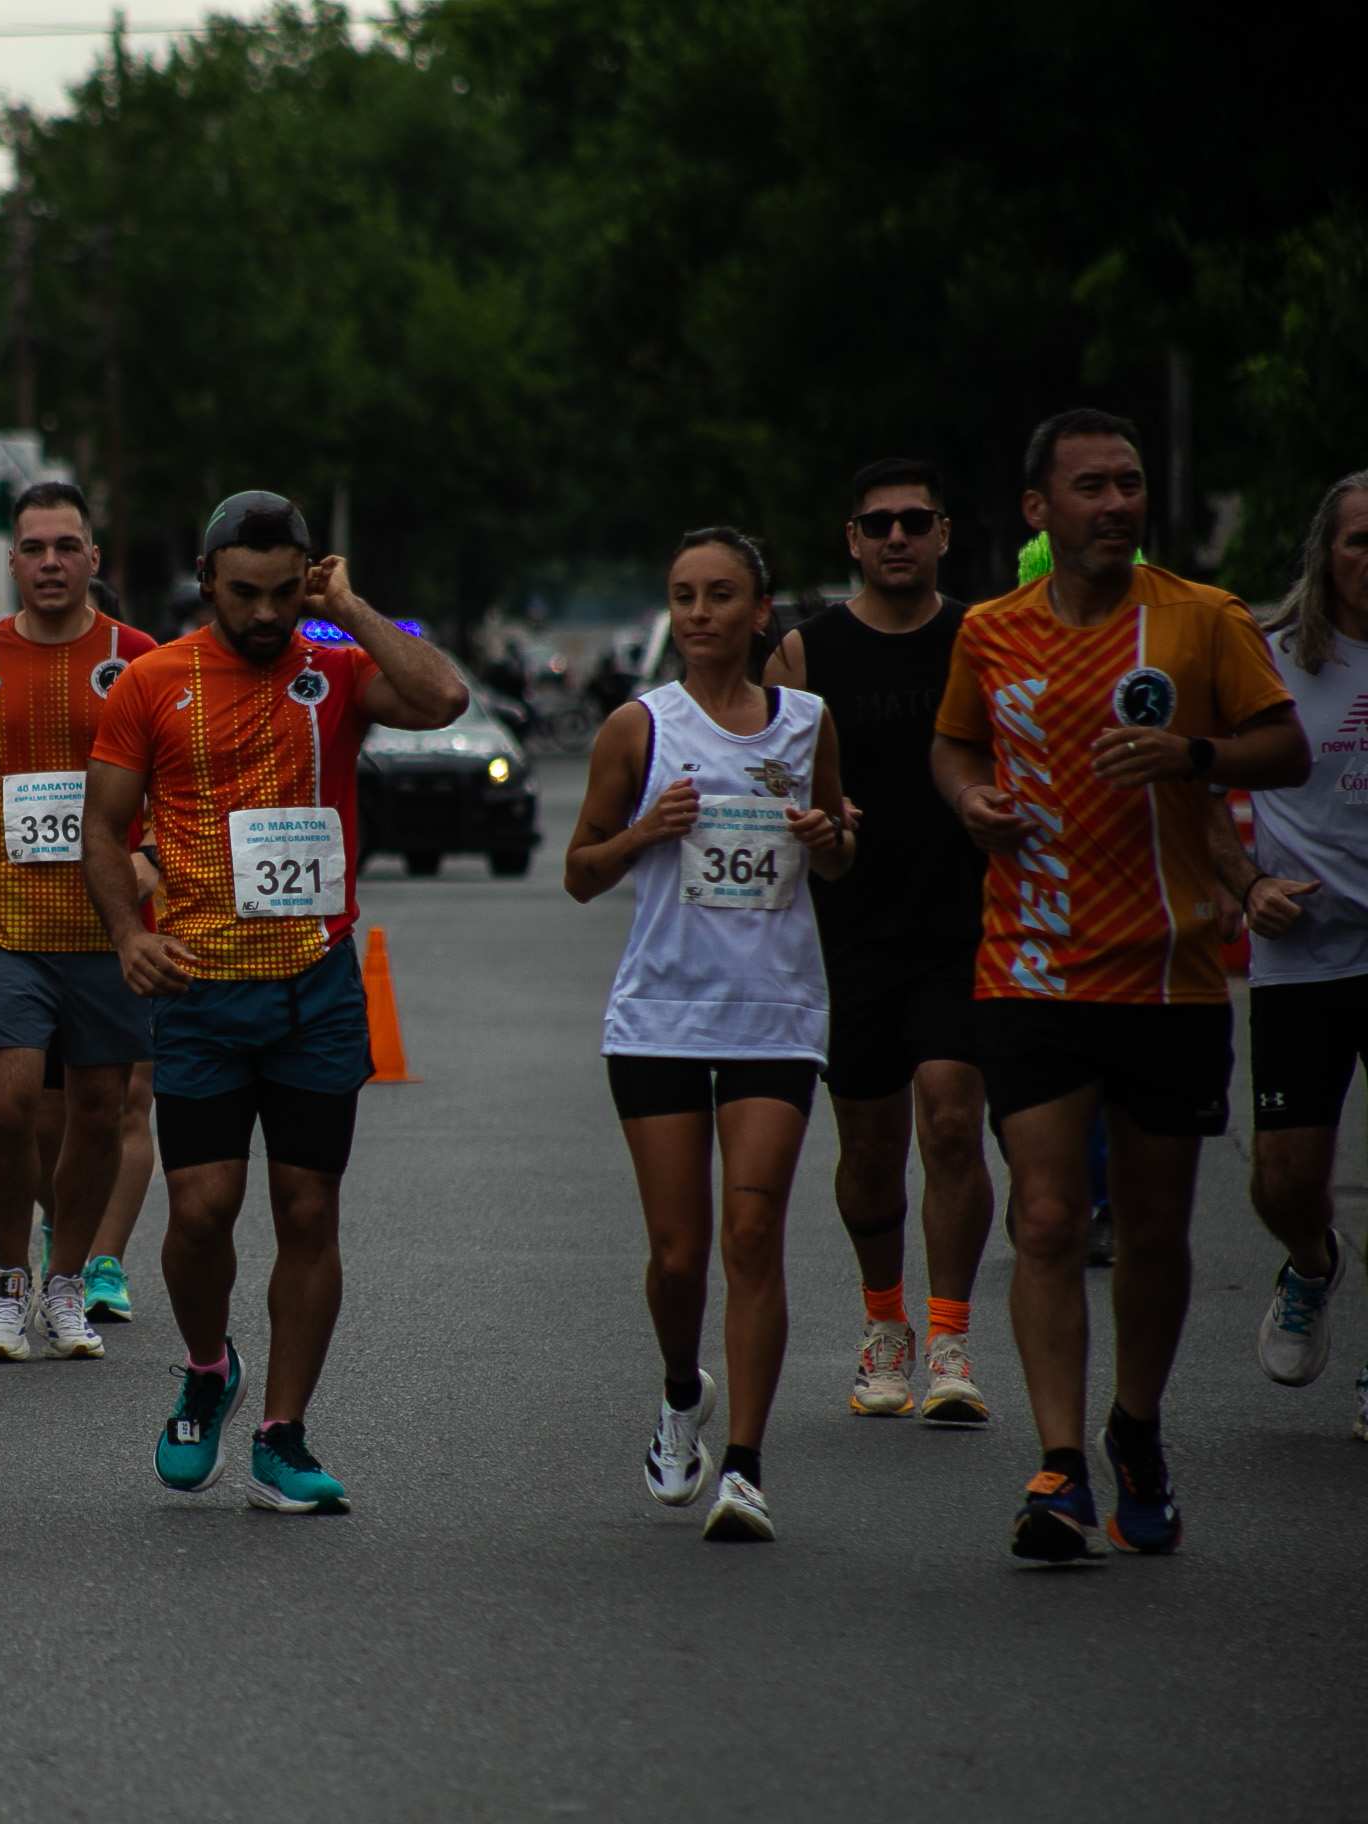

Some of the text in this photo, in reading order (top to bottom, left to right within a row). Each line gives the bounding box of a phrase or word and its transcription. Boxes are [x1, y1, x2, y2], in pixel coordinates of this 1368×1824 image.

[1321, 741, 1356, 753] new
[32, 782, 83, 792] MARATON
[702, 808, 784, 819] 40 MARATON
[21, 814, 80, 845] 336
[249, 821, 326, 831] 40 MARATON
[698, 822, 741, 830] EMPALME
[247, 836, 287, 844] EMPALME
[702, 848, 779, 885] 364
[255, 859, 321, 895] 321
